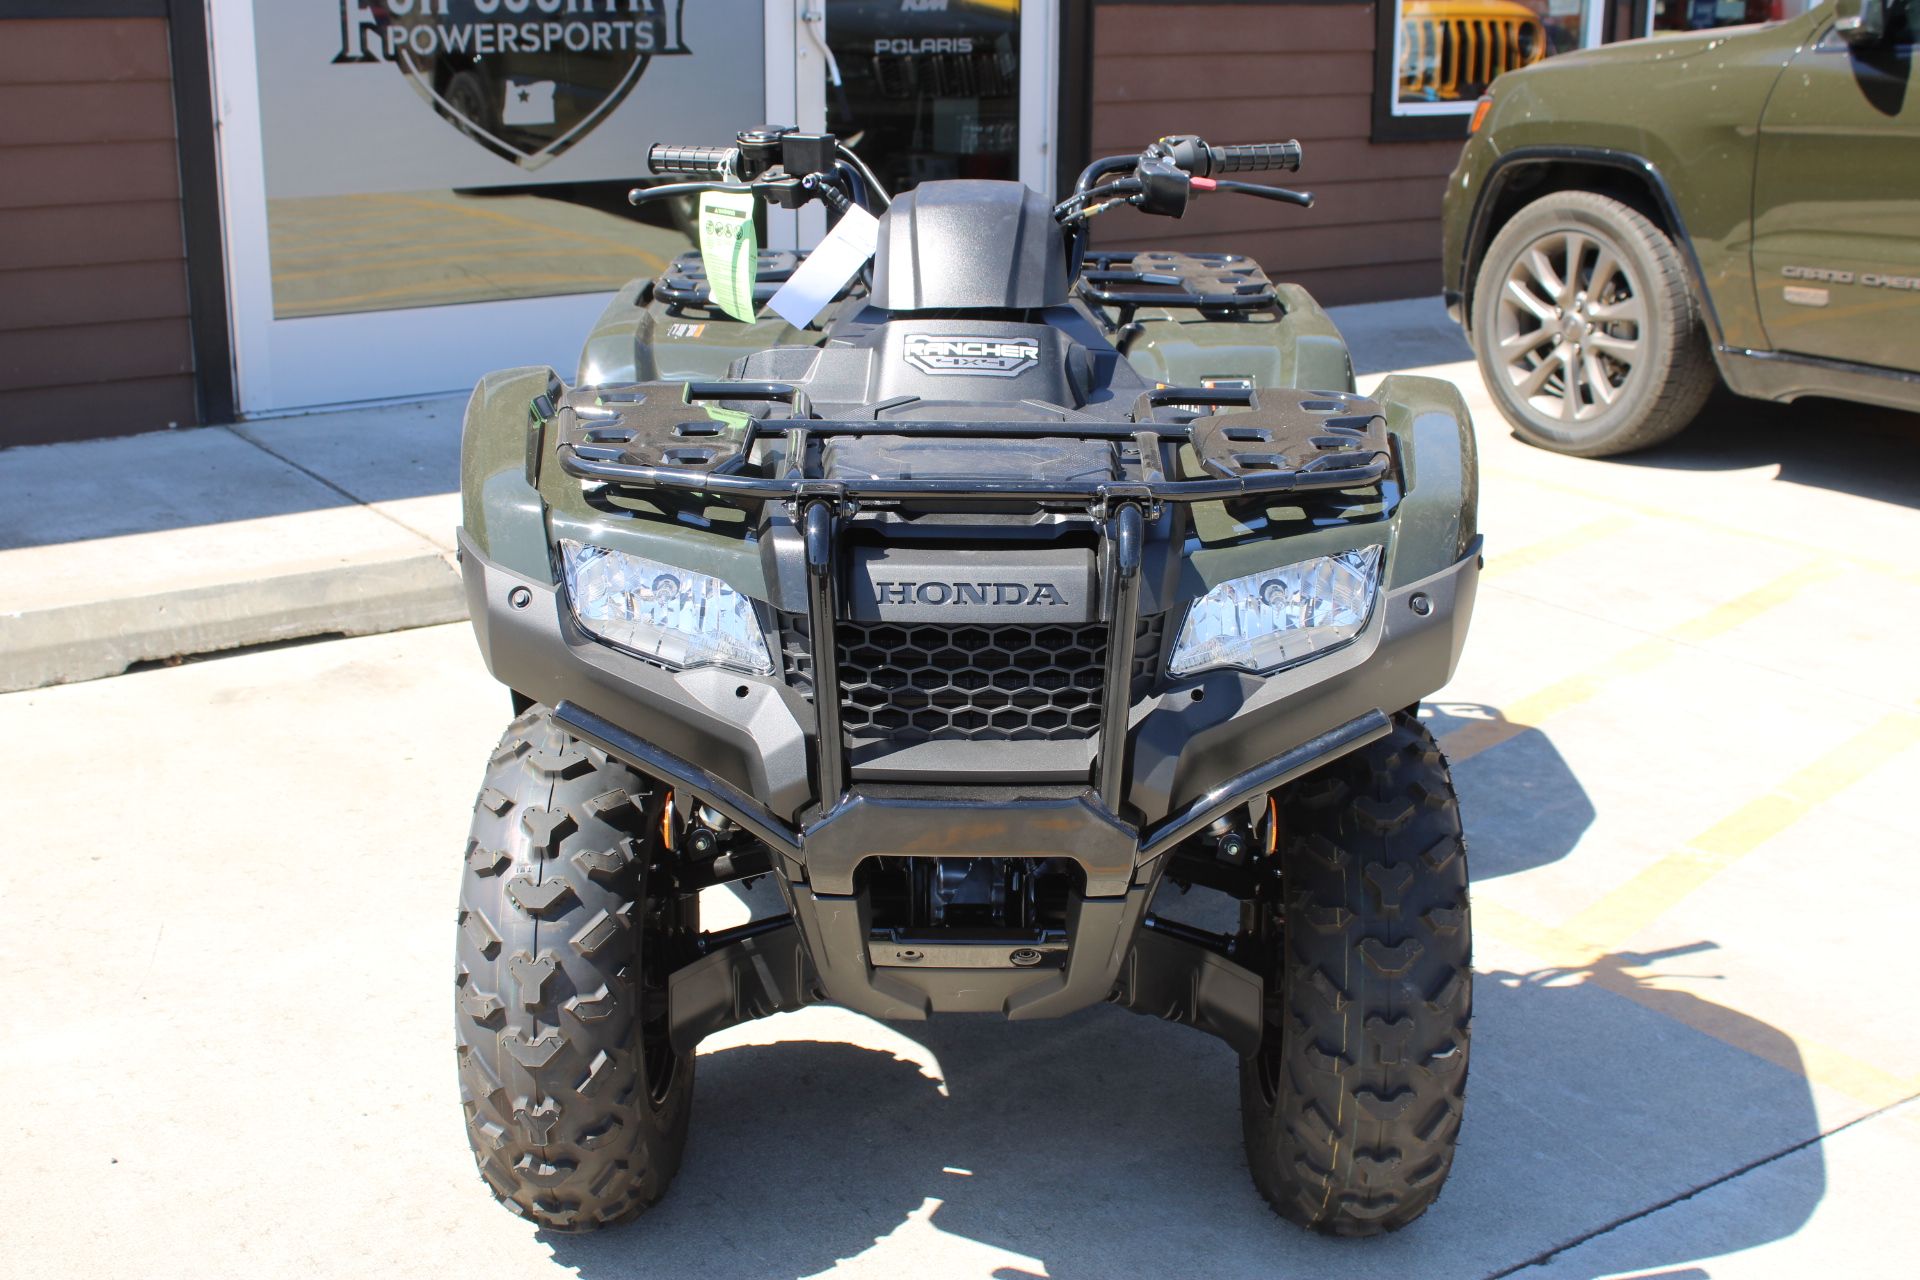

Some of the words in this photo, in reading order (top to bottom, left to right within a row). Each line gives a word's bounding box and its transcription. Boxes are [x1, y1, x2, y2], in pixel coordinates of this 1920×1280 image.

[386, 21, 655, 56] POWERSPORTS
[874, 38, 973, 54] POLARIS
[904, 342, 1039, 360] RANCHER
[876, 581, 1069, 606] HONDA
